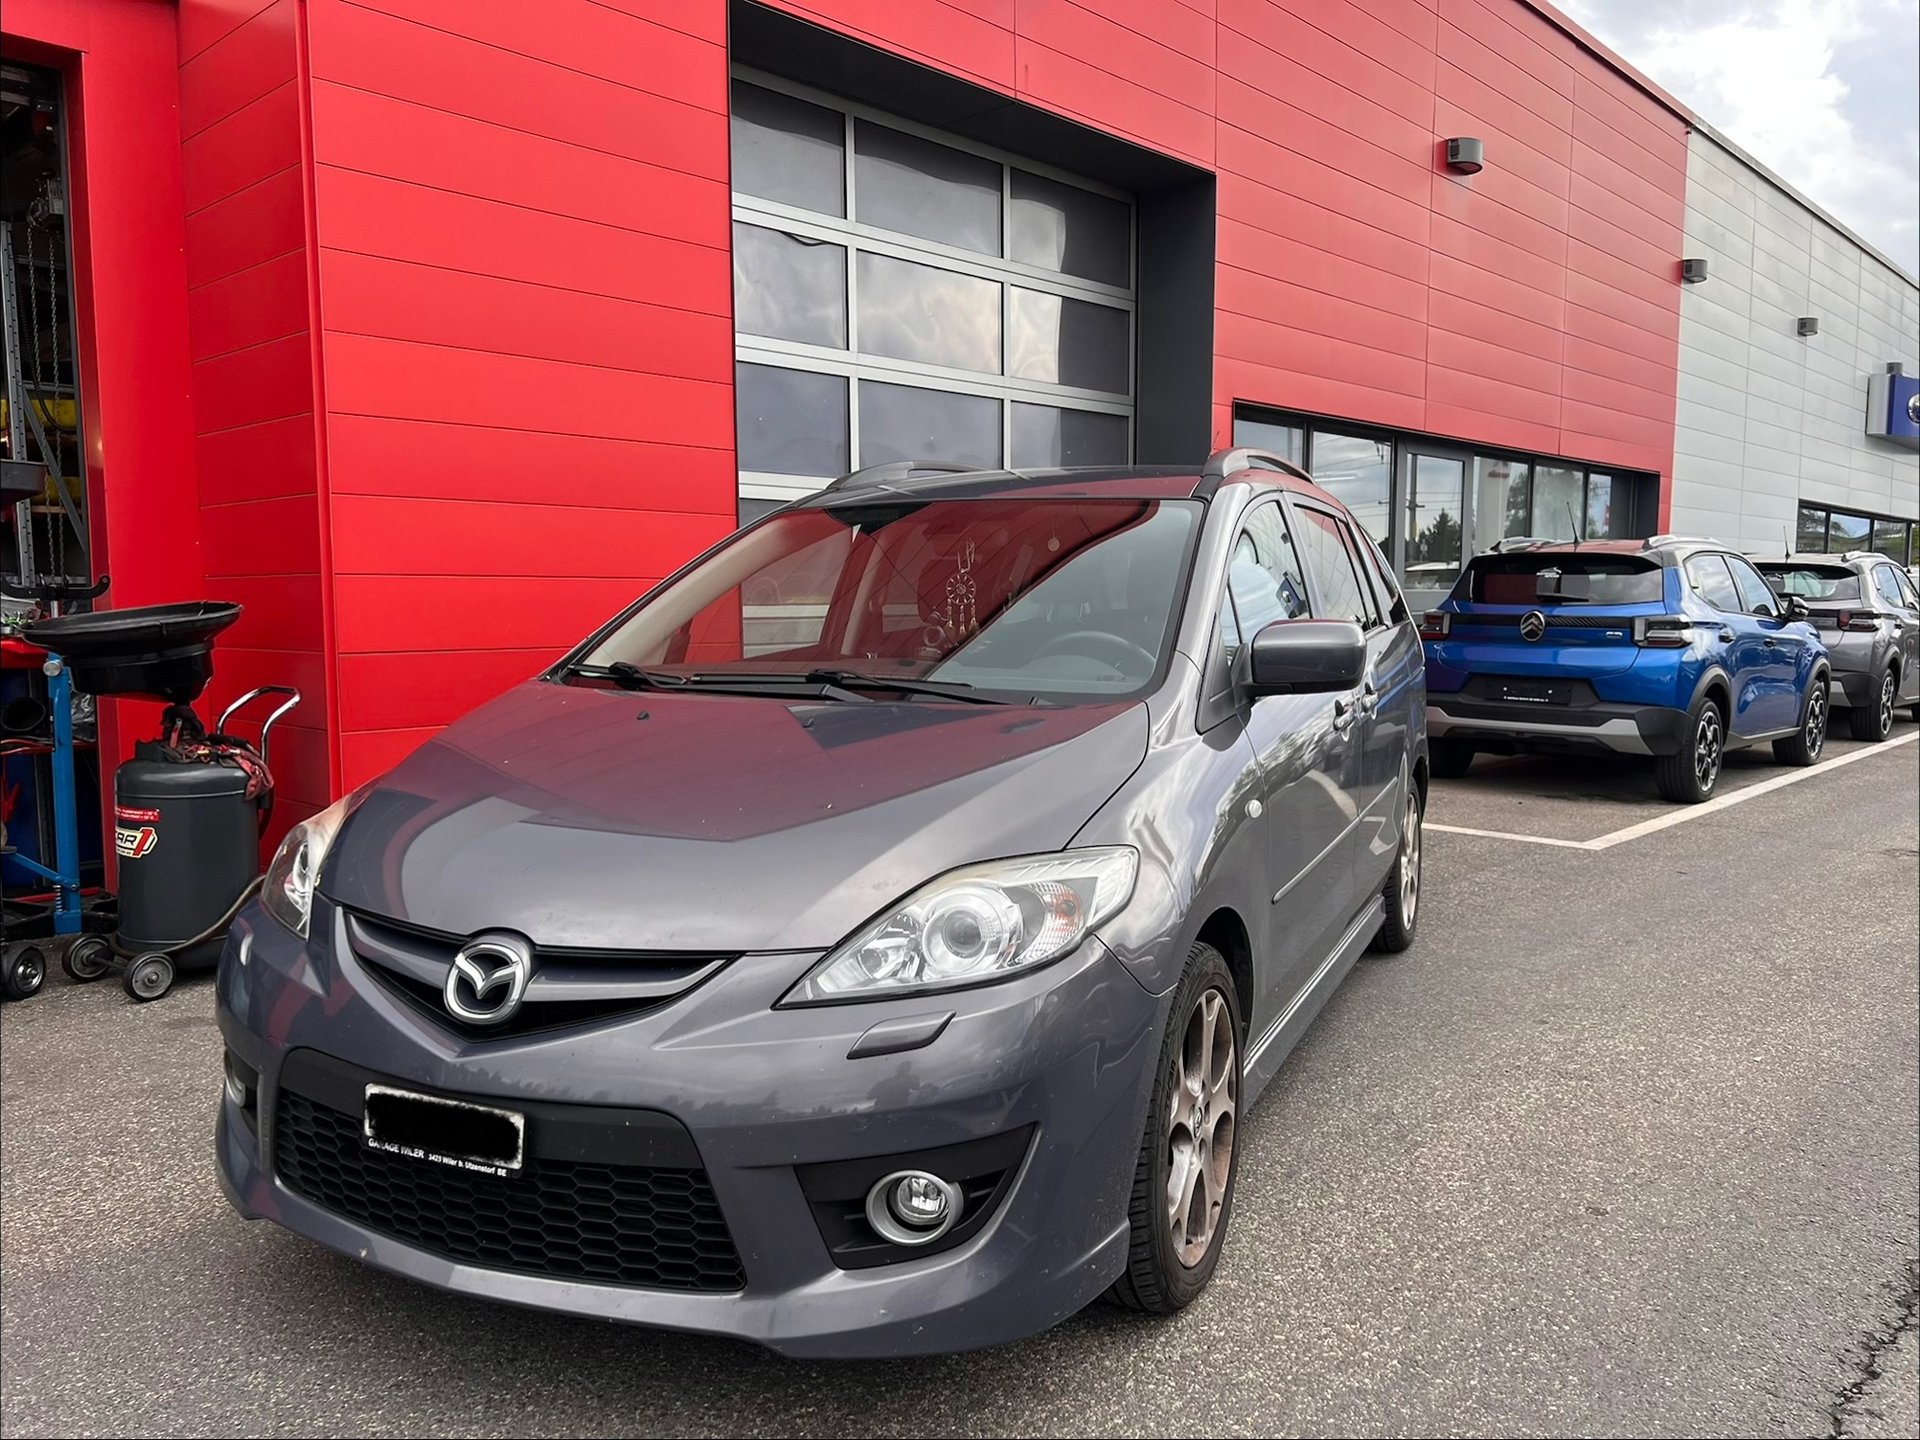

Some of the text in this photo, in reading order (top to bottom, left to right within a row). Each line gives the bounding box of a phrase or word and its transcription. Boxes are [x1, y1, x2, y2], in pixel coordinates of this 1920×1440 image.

[116, 828, 153, 856] AR1
[400, 1145, 425, 1159] WILER
[442, 1156, 457, 1166] Wiler
